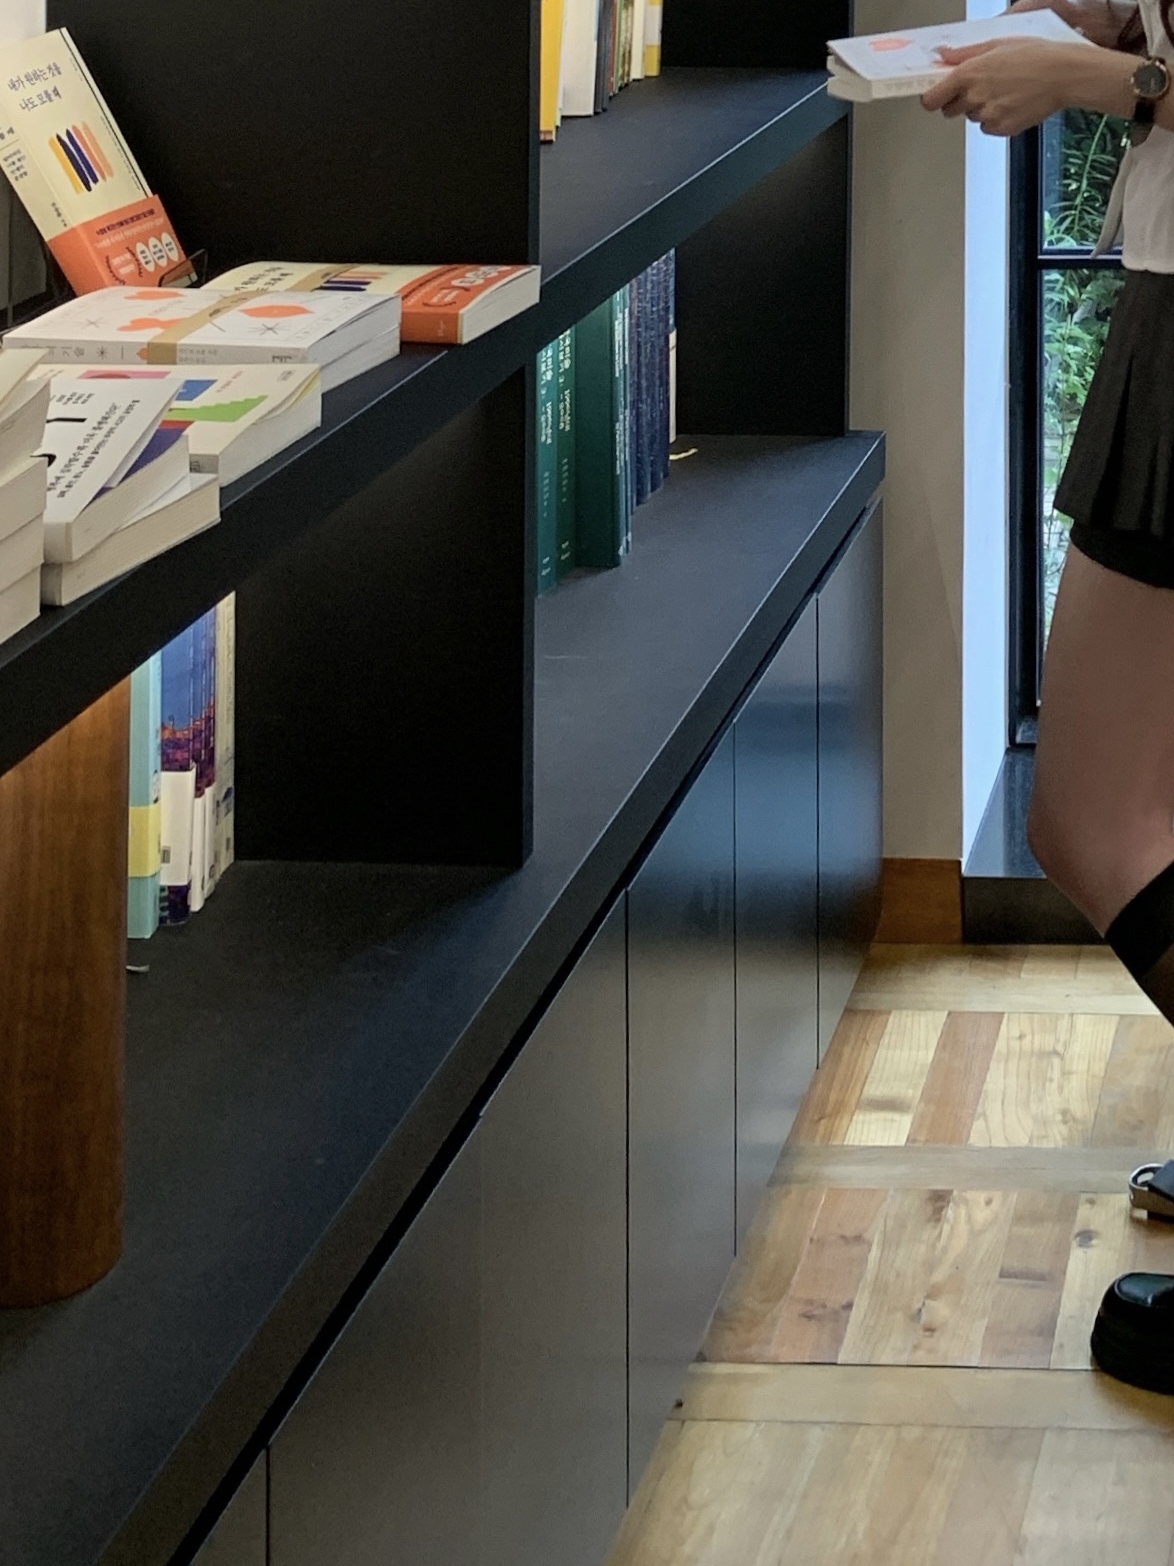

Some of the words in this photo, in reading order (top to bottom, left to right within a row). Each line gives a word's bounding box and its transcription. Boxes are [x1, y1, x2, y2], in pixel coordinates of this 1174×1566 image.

[7, 75, 26, 91] 내가
[24, 68, 49, 86] 원하는
[19, 97, 39, 112] 나도
[36, 89, 54, 105] 모를
